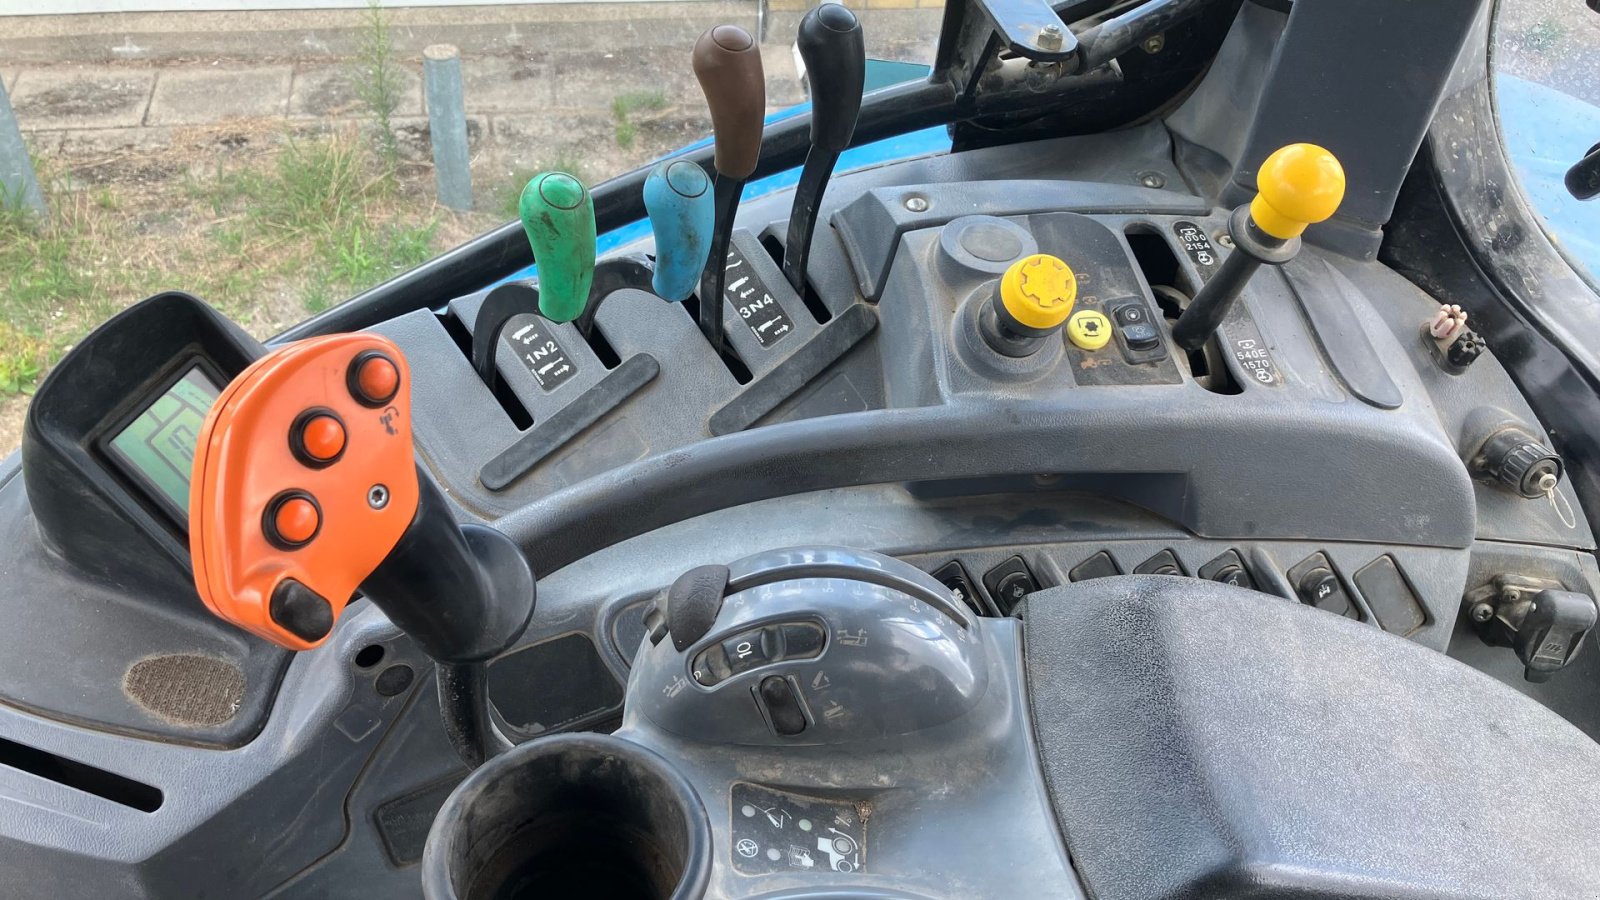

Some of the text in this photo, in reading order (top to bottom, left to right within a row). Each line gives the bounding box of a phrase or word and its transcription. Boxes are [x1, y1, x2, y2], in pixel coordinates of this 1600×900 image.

[1180, 234, 1206, 242] 1000
[1186, 242, 1210, 250] 2154
[1237, 348, 1267, 360] 540E
[1243, 360, 1269, 369] 1570
[737, 642, 753, 658] 10
